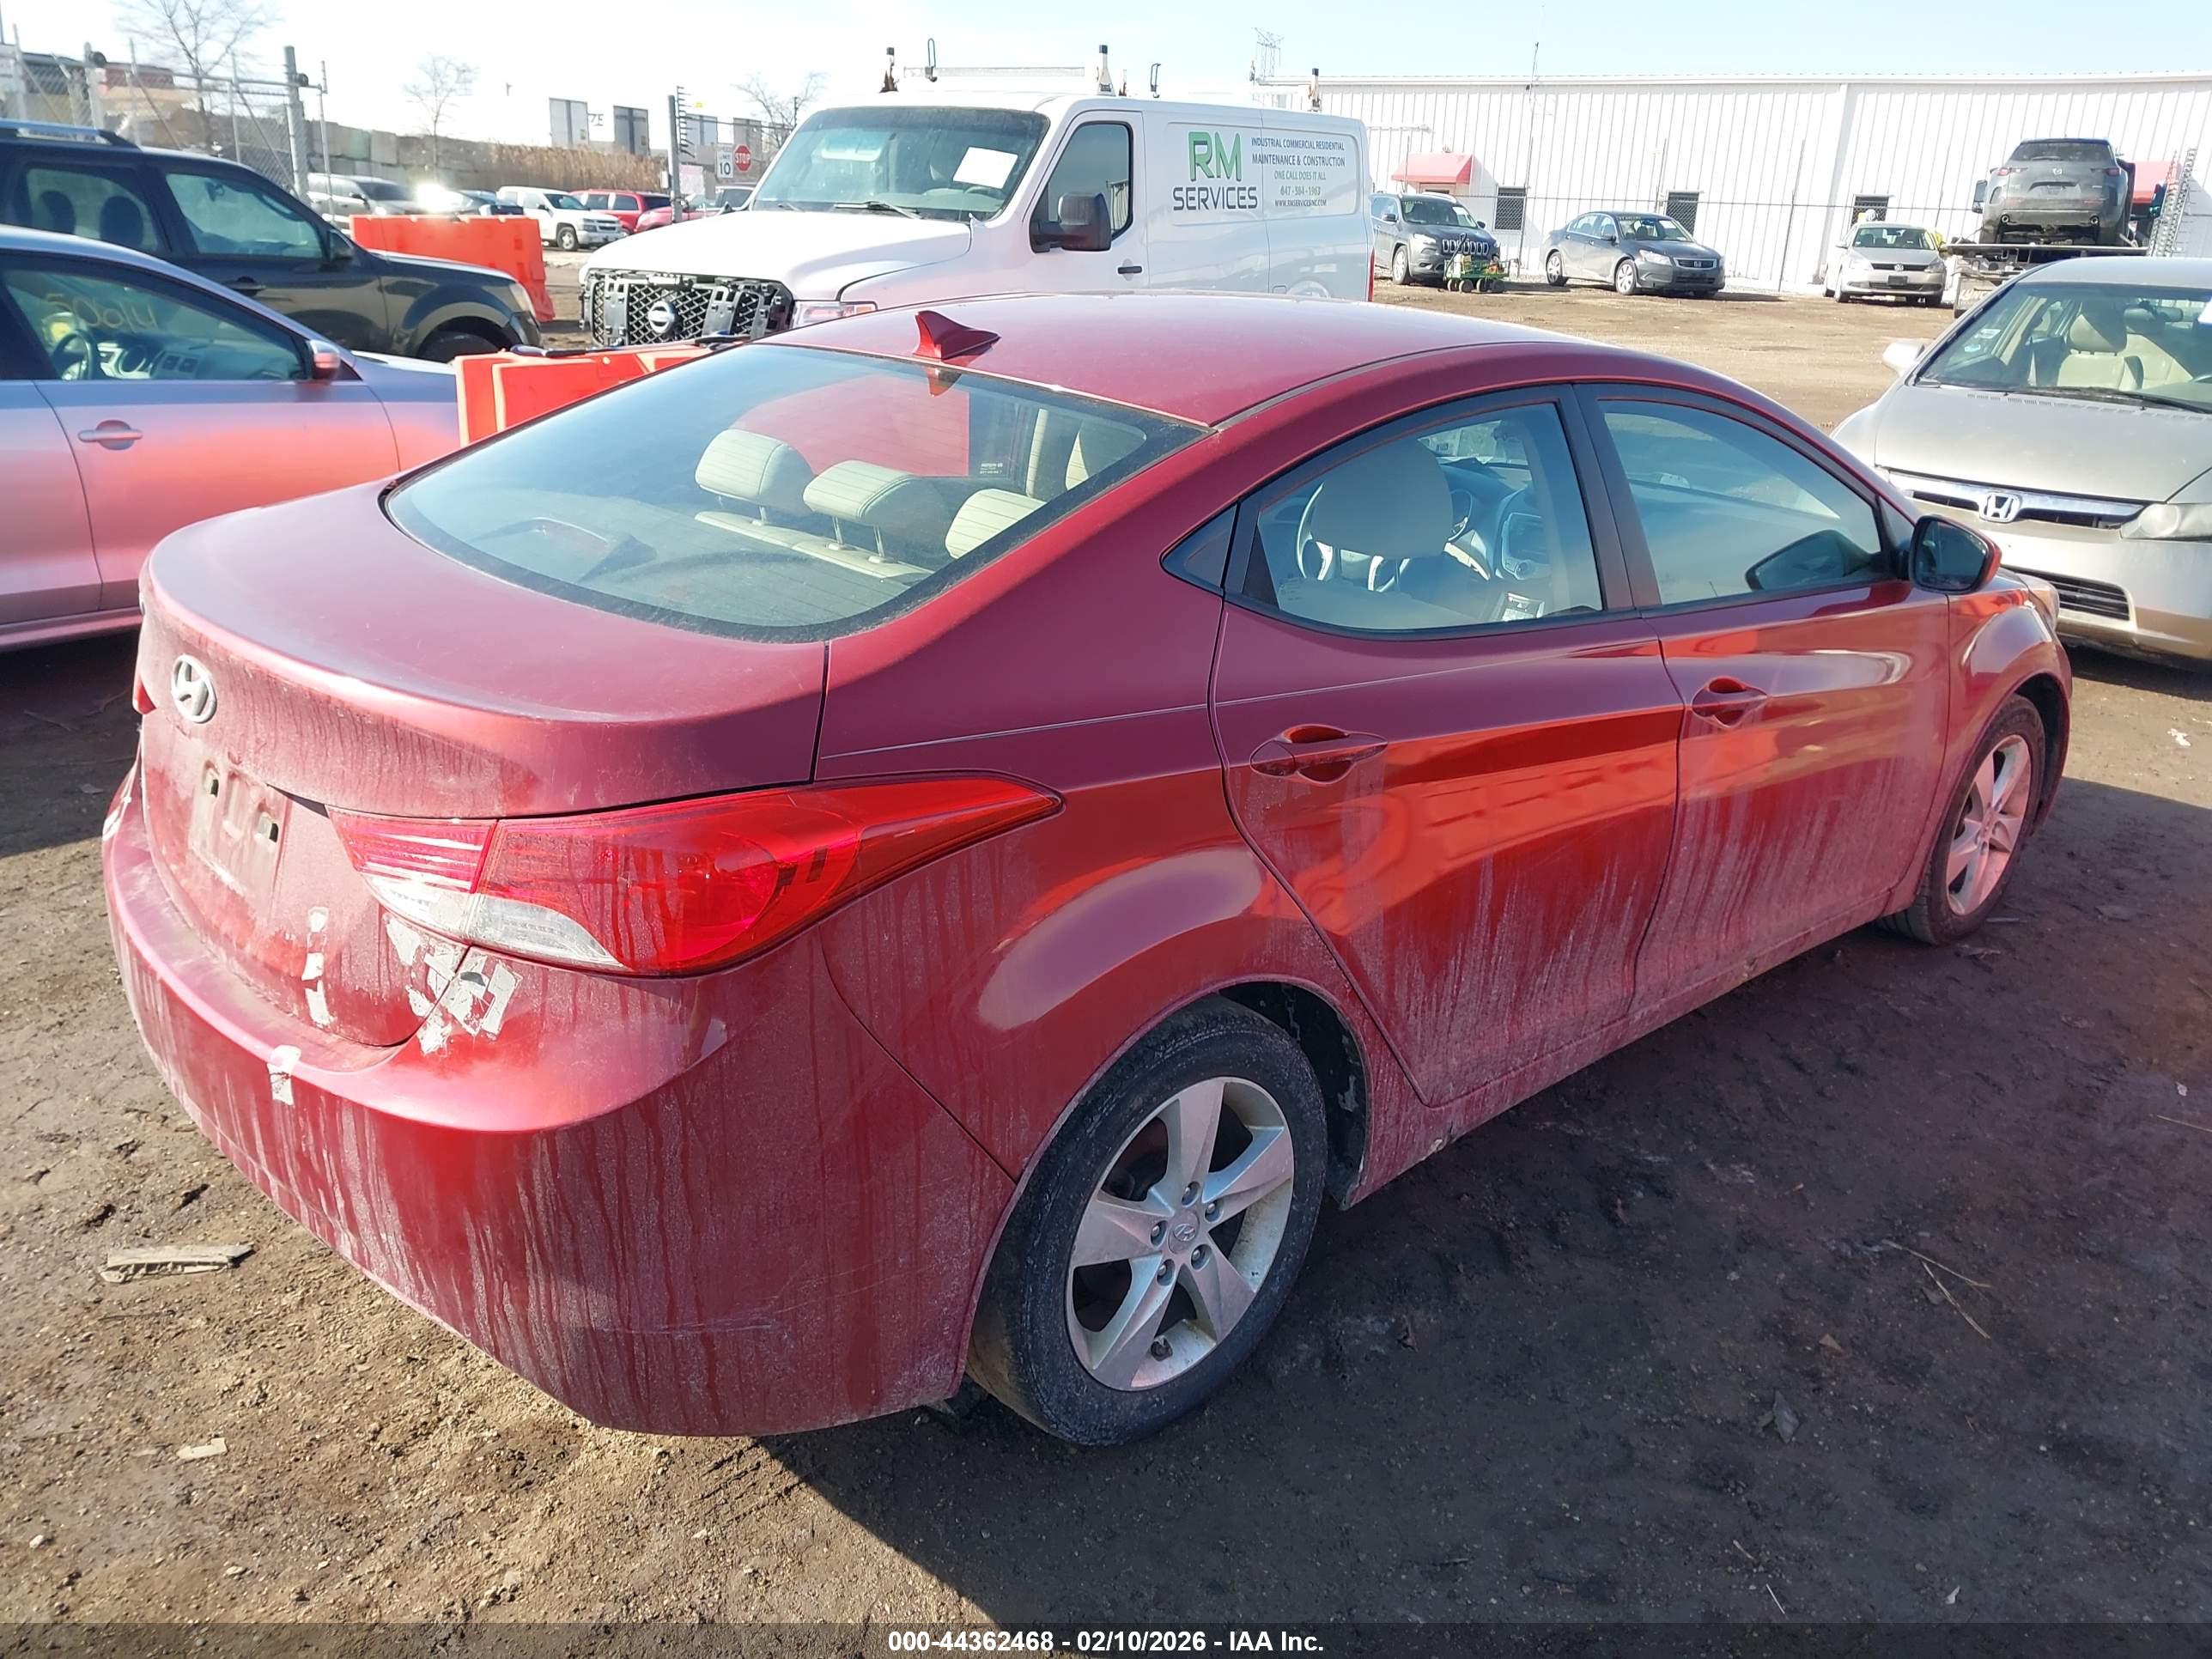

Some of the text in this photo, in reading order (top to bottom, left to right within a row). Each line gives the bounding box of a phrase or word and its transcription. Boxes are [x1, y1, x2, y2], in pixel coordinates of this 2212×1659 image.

[1251, 137, 1345, 151] INDUSTRIAL COMMERCIAL RESIDENTIAL
[735, 152, 750, 164] STOP
[1188, 131, 1242, 182] RM
[1252, 154, 1346, 167] MAINTENANCE & CONSTRUCTION
[720, 161, 731, 175] 10
[1274, 170, 1327, 180] ONE CALL DOES IT ALL
[1172, 186, 1258, 211] SERVICES
